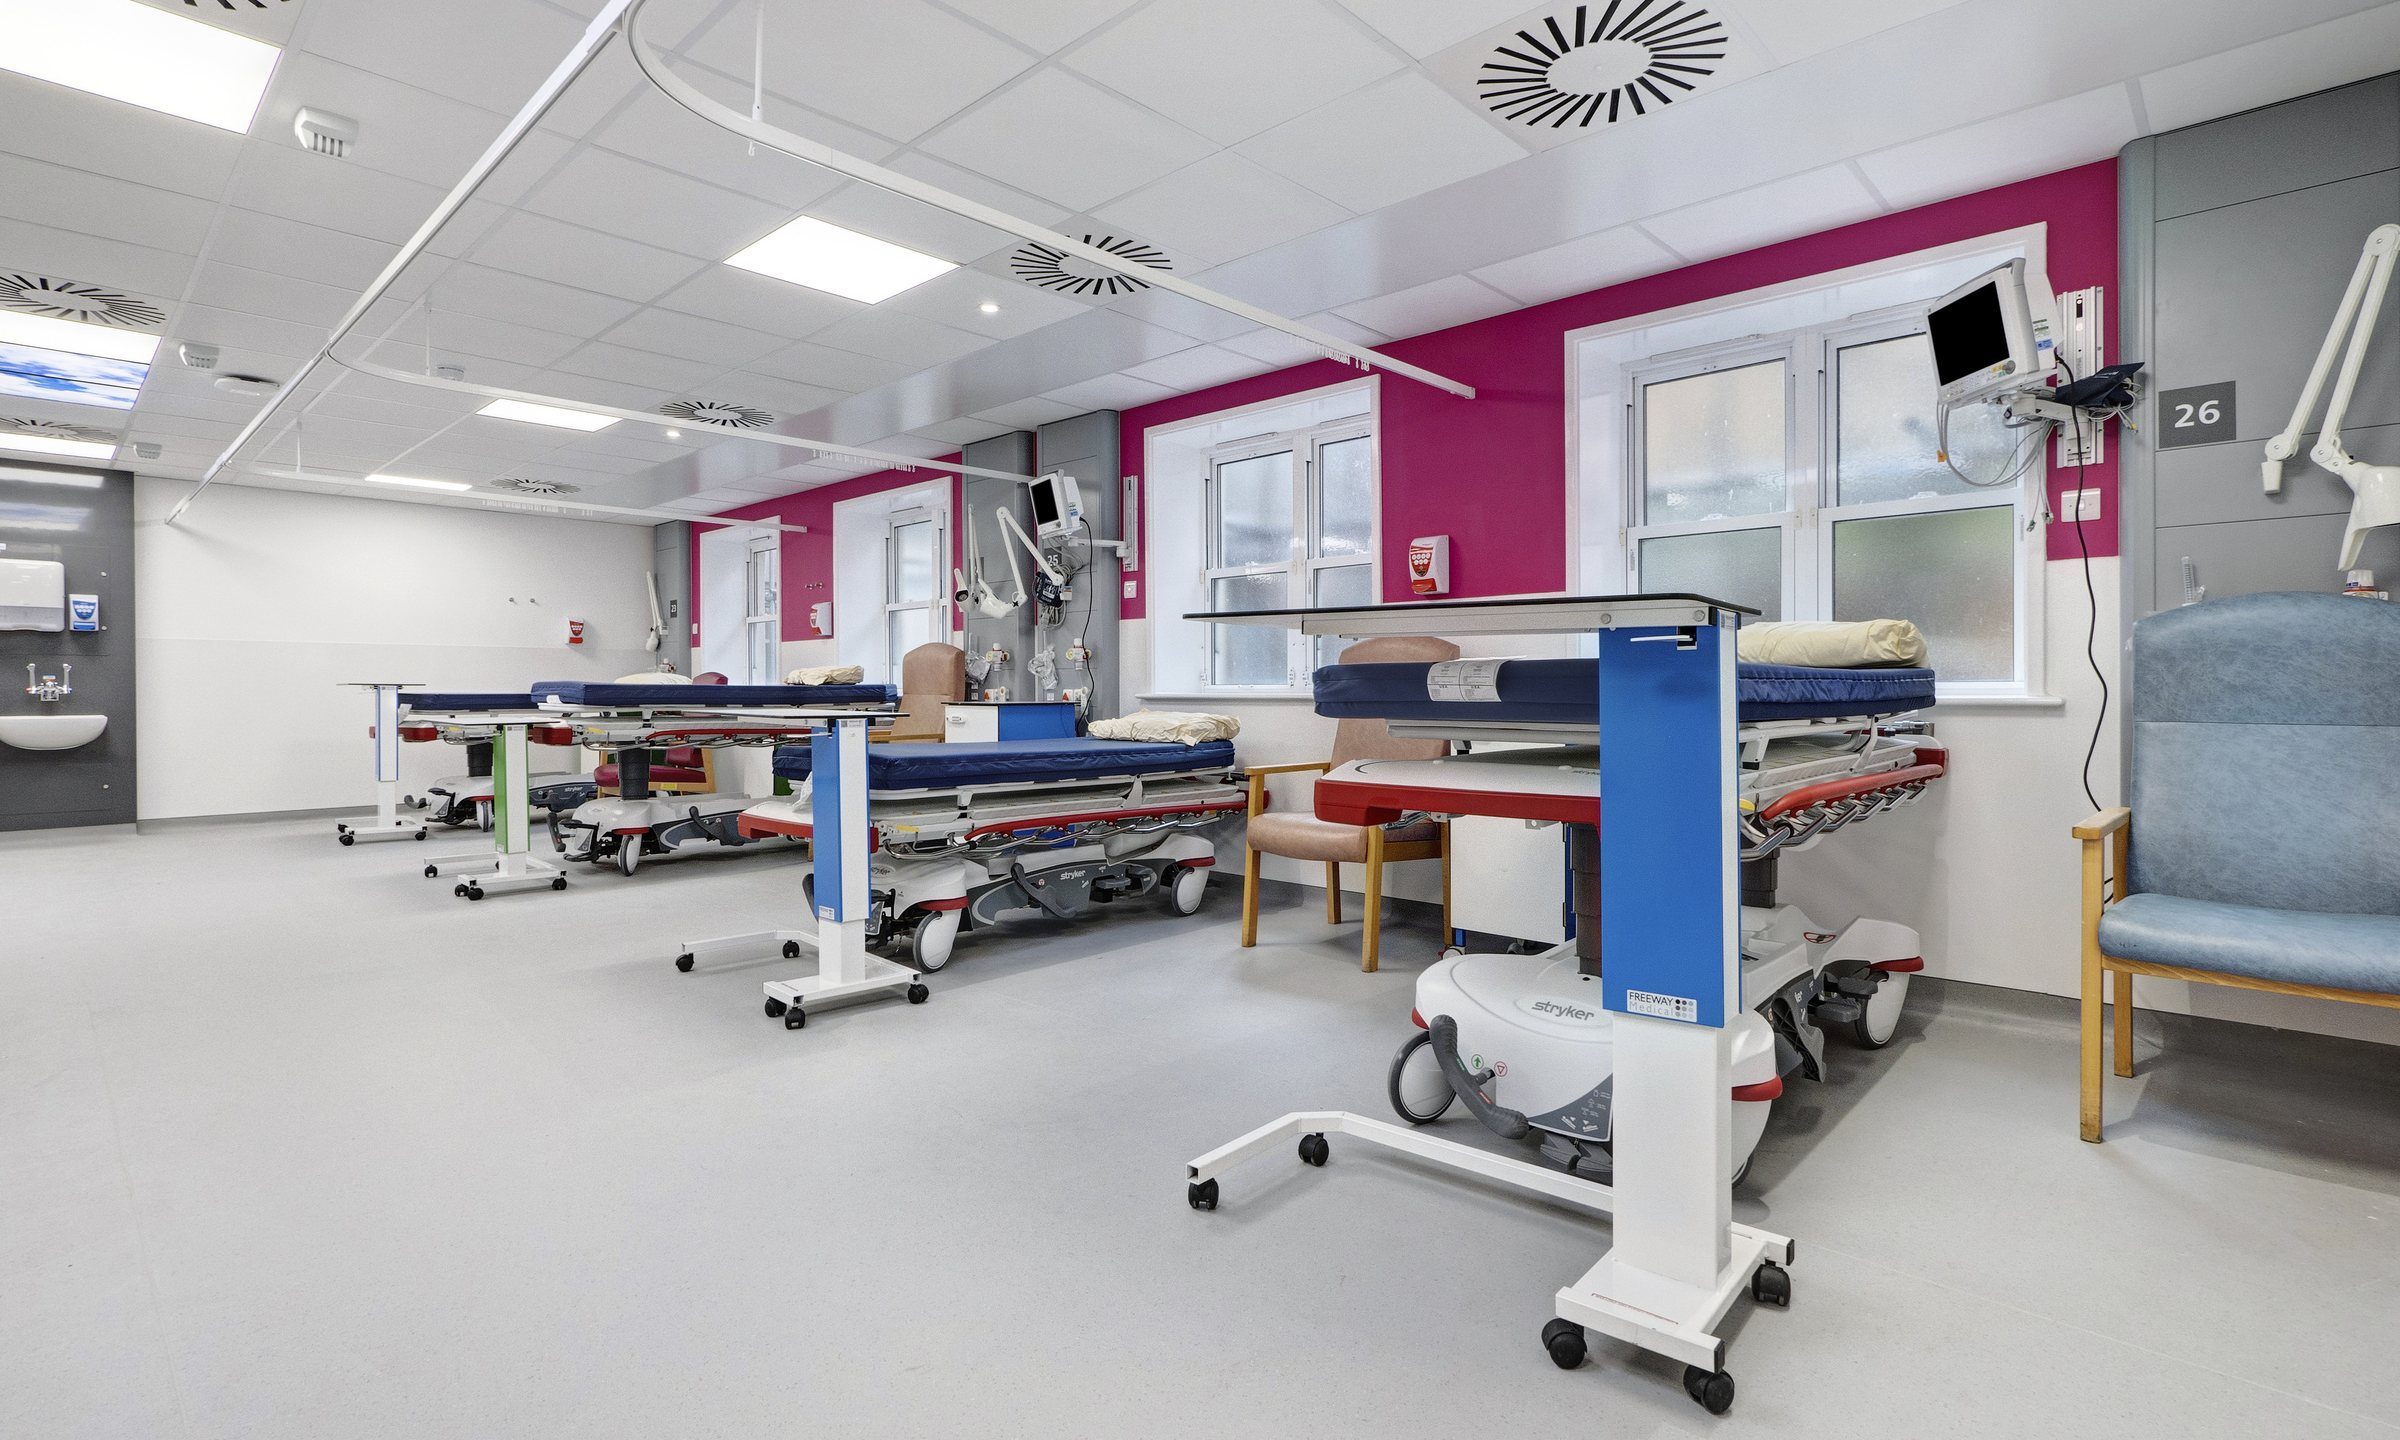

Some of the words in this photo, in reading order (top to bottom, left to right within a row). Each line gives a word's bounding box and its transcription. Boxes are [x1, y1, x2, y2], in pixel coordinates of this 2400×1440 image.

[2175, 400, 2220, 428] 26
[1048, 555, 1059, 567] 25
[1060, 869, 1086, 881] stryker
[1629, 992, 1674, 1006] FREEWAY
[1531, 1001, 1594, 1021] stryker
[1629, 1001, 1674, 1016] Medical
